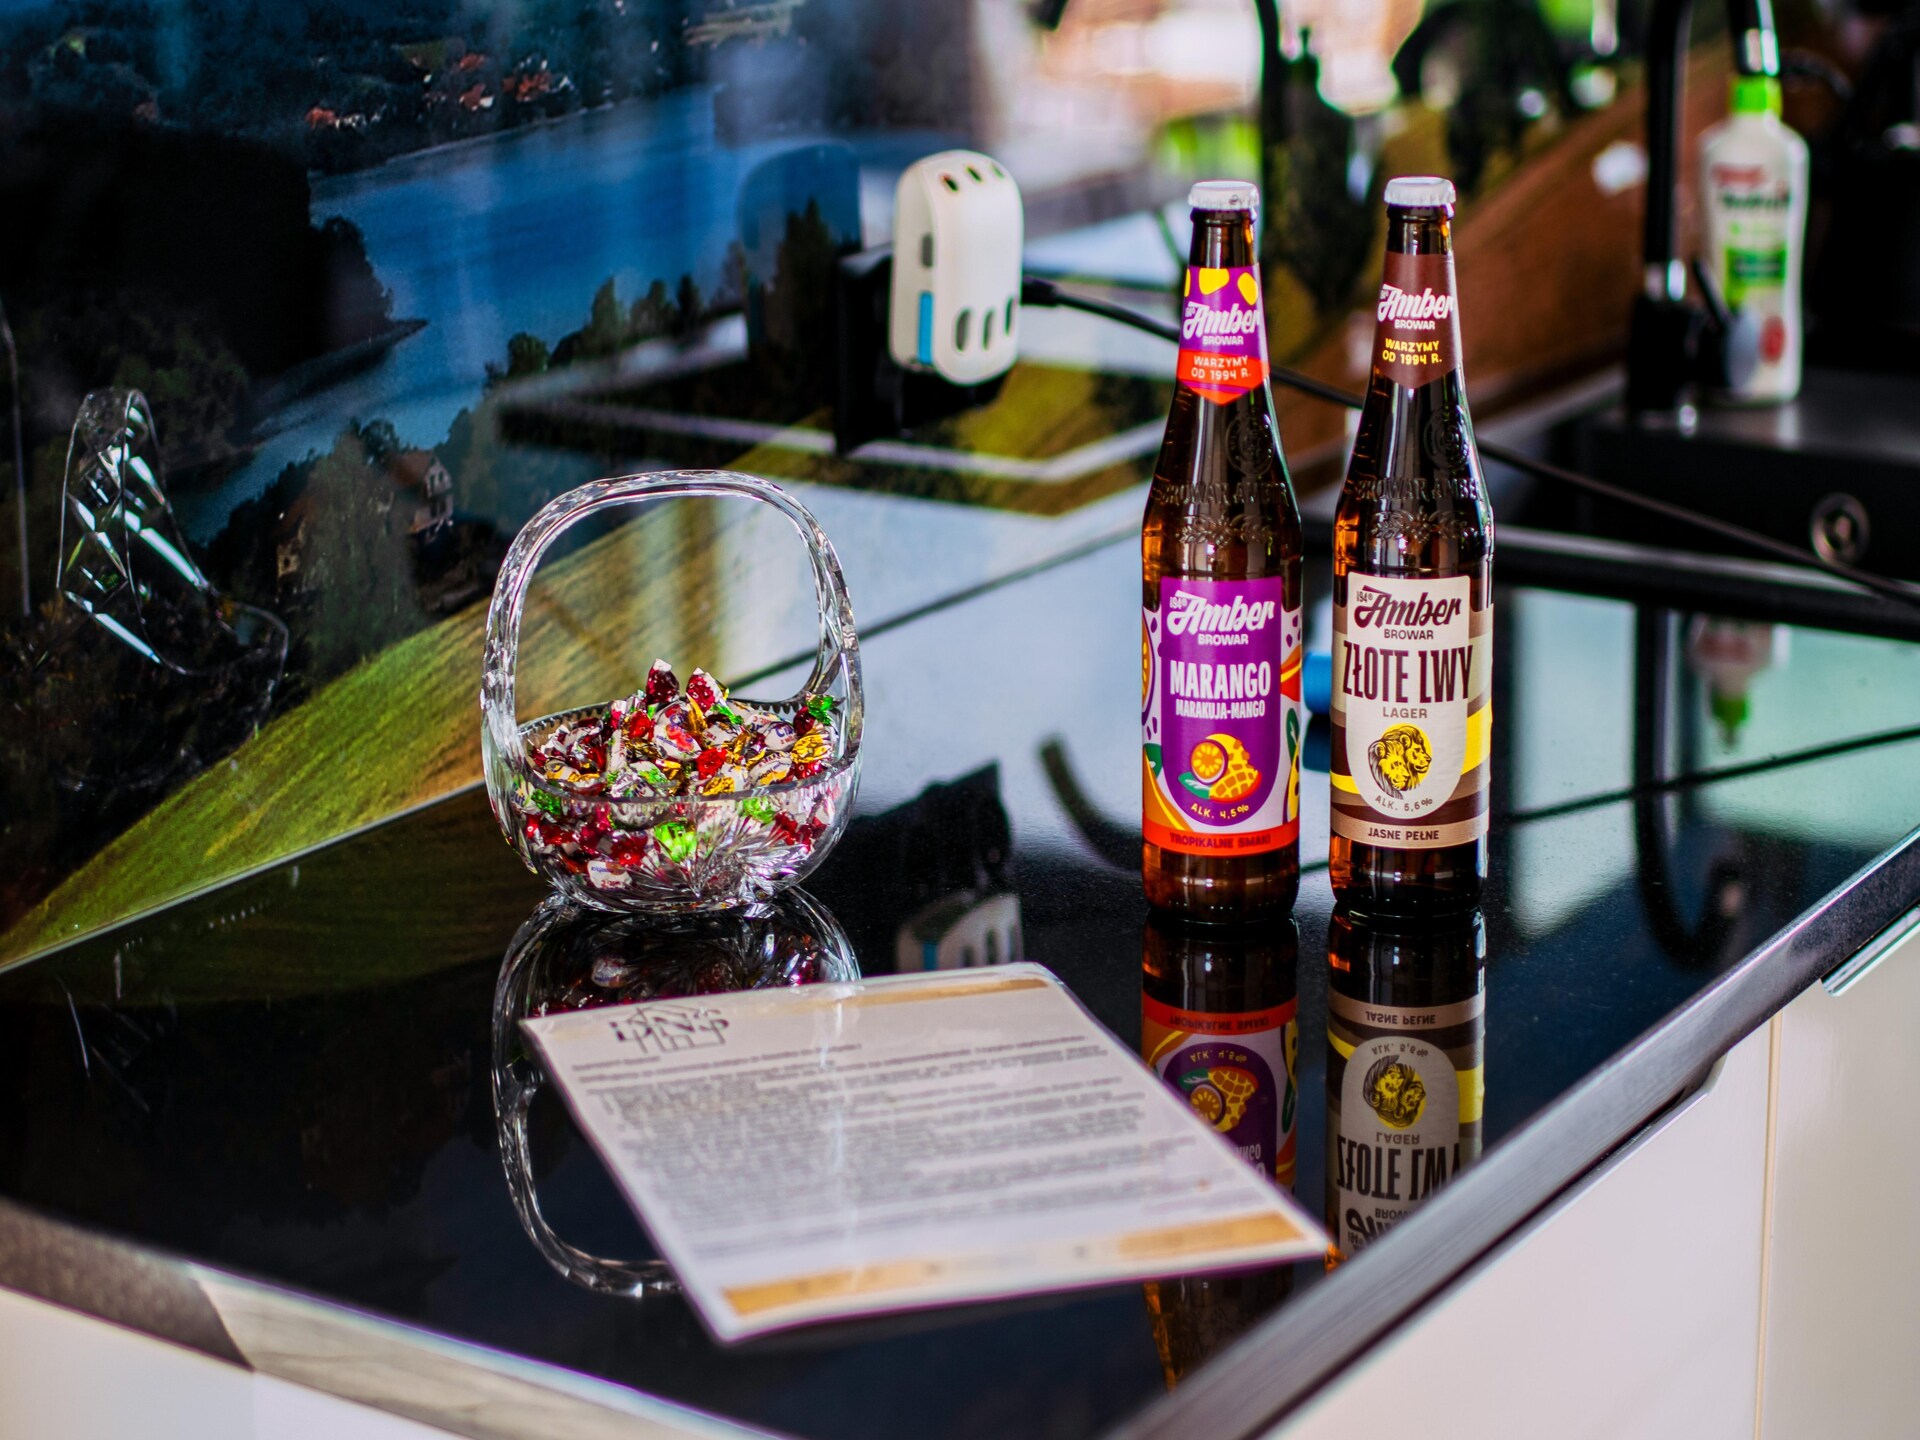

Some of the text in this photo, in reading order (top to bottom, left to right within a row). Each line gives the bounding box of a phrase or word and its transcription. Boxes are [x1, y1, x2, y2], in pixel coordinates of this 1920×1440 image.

[1378, 284, 1454, 322] Amber
[1183, 301, 1260, 339] Amber
[1394, 320, 1436, 330] BROWAR
[1202, 336, 1244, 346] BROWAR
[1386, 338, 1440, 352] WARZYMY
[1194, 355, 1248, 368] WARZYMY
[1382, 350, 1442, 365] OD 1994 R.
[1191, 368, 1205, 379] OD
[1210, 370, 1236, 380] 1994
[1166, 590, 1275, 636] Amber
[1354, 585, 1462, 628] Amber
[1198, 634, 1248, 646] BROWAR
[1384, 628, 1434, 640] BROWAR
[1343, 640, 1473, 703] ZŁOTE LWY
[1170, 660, 1271, 699] MARANGO
[1176, 699, 1265, 719] MARAKUJA-MANGO
[1383, 706, 1427, 718] LAGER
[1191, 803, 1214, 819] ALK.
[1375, 795, 1433, 812] ALK. 5,6%
[1170, 832, 1270, 848] TROPIKALNE SMAKI
[1368, 827, 1439, 841] JASNE PEŁNE
